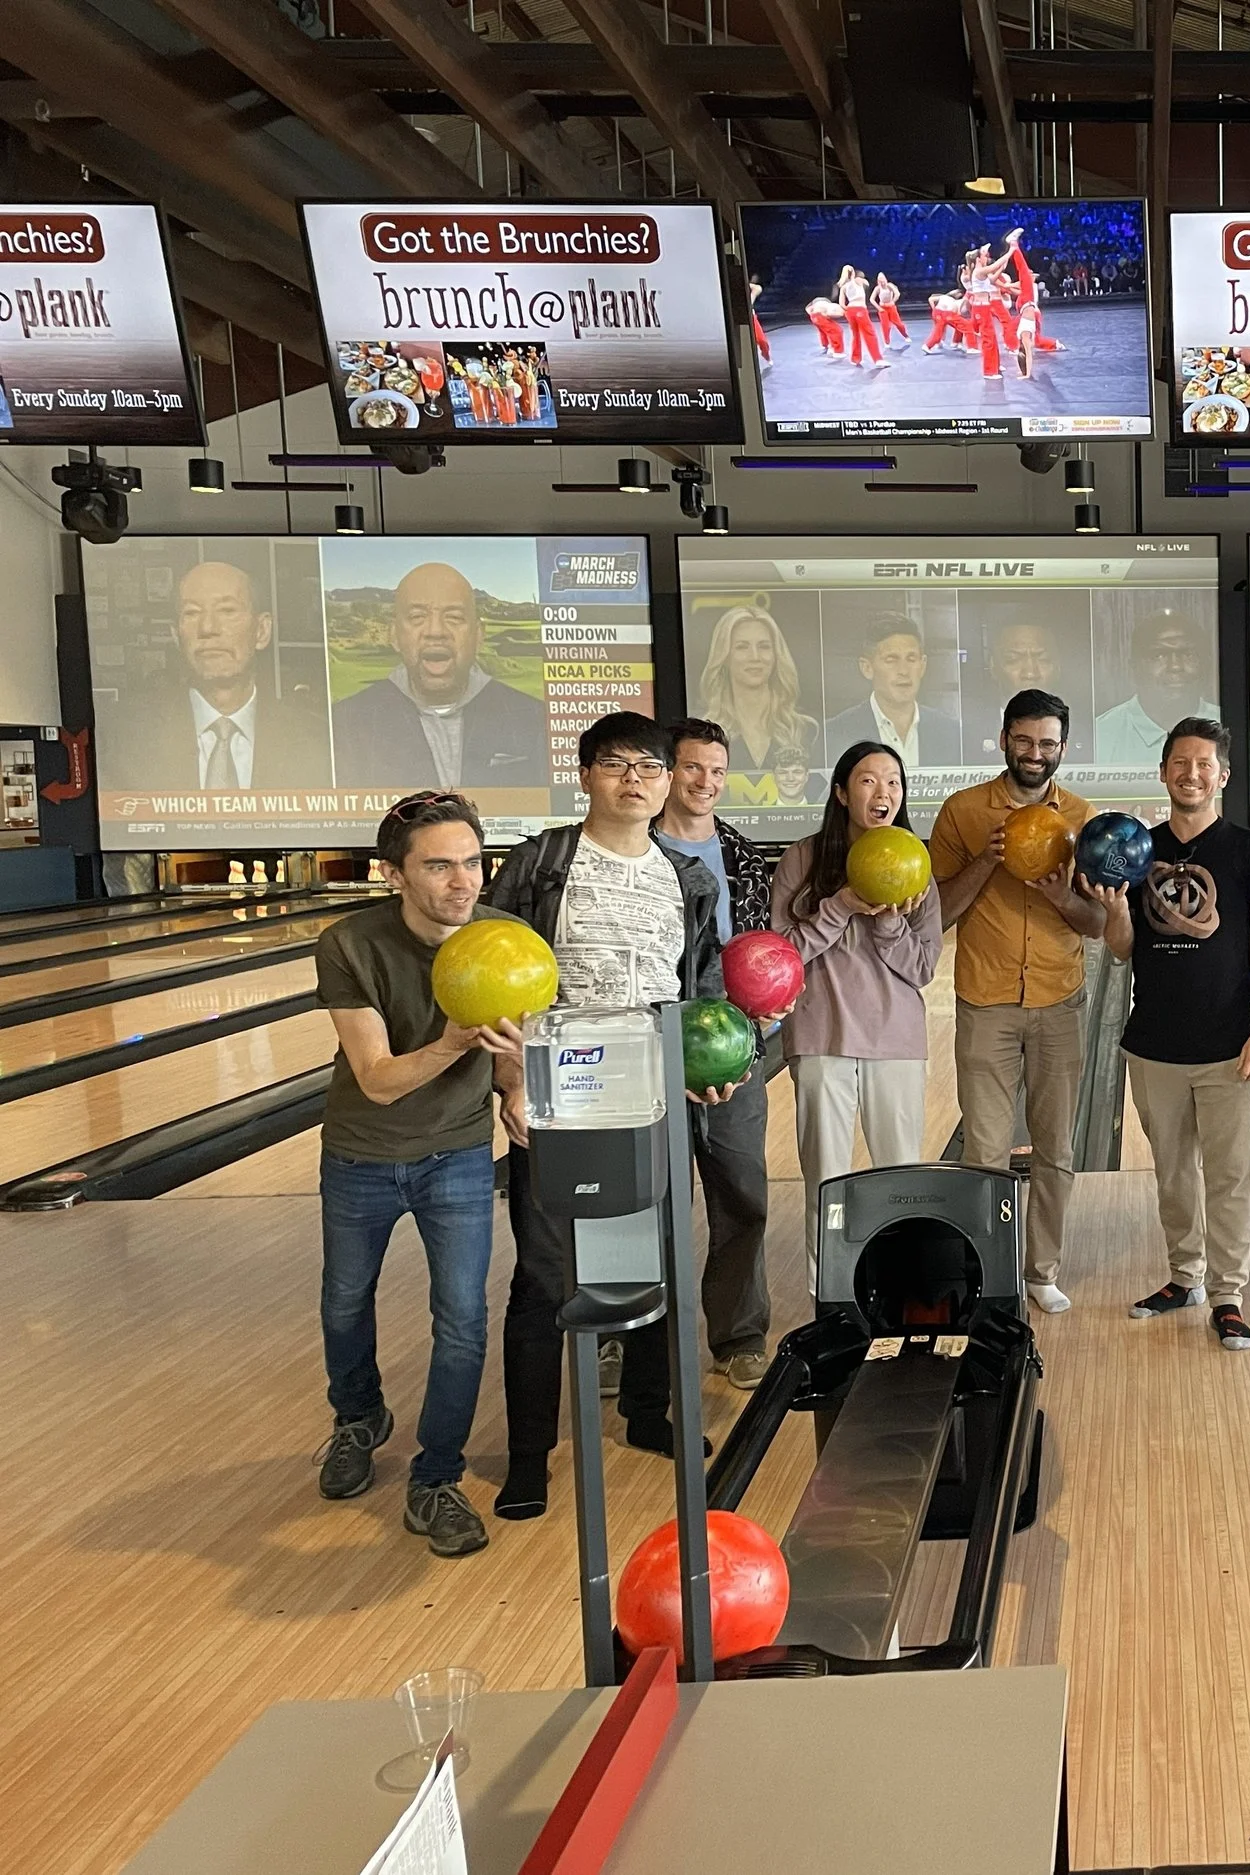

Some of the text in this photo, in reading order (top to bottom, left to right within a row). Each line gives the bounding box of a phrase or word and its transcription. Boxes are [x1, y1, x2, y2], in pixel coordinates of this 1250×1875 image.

[374, 222, 650, 254] Got the Brunchies?
[12, 388, 53, 410] Every
[58, 389, 107, 411] Sunday
[558, 388, 599, 411] Every
[604, 389, 652, 411] Sunday
[570, 557, 615, 570] MARCH
[874, 563, 1034, 577] ESPN NFL LIVE
[576, 571, 637, 584] MADNESS
[544, 607, 577, 621] 0:00
[545, 628, 617, 640] RUNDOWN
[545, 647, 608, 659] VIRGINIA
[547, 665, 631, 678] NCAA PICKS
[548, 684, 641, 696] DODGERS/PADS
[550, 701, 621, 714] BRACKETS
[551, 737, 576, 749] EPIC
[552, 755, 580, 766] USC
[941, 774, 966, 783] Mel
[1064, 772, 1074, 781] 4
[1077, 772, 1096, 782] QB
[923, 787, 940, 796] for
[152, 798, 207, 813] WHICH
[213, 797, 257, 812] TEAM
[262, 796, 301, 812] WILL
[306, 796, 336, 812] WIN
[344, 796, 358, 811] IT
[1105, 853, 1127, 873] 12
[562, 1050, 600, 1064] Purell
[1000, 1199, 1012, 1222] 8
